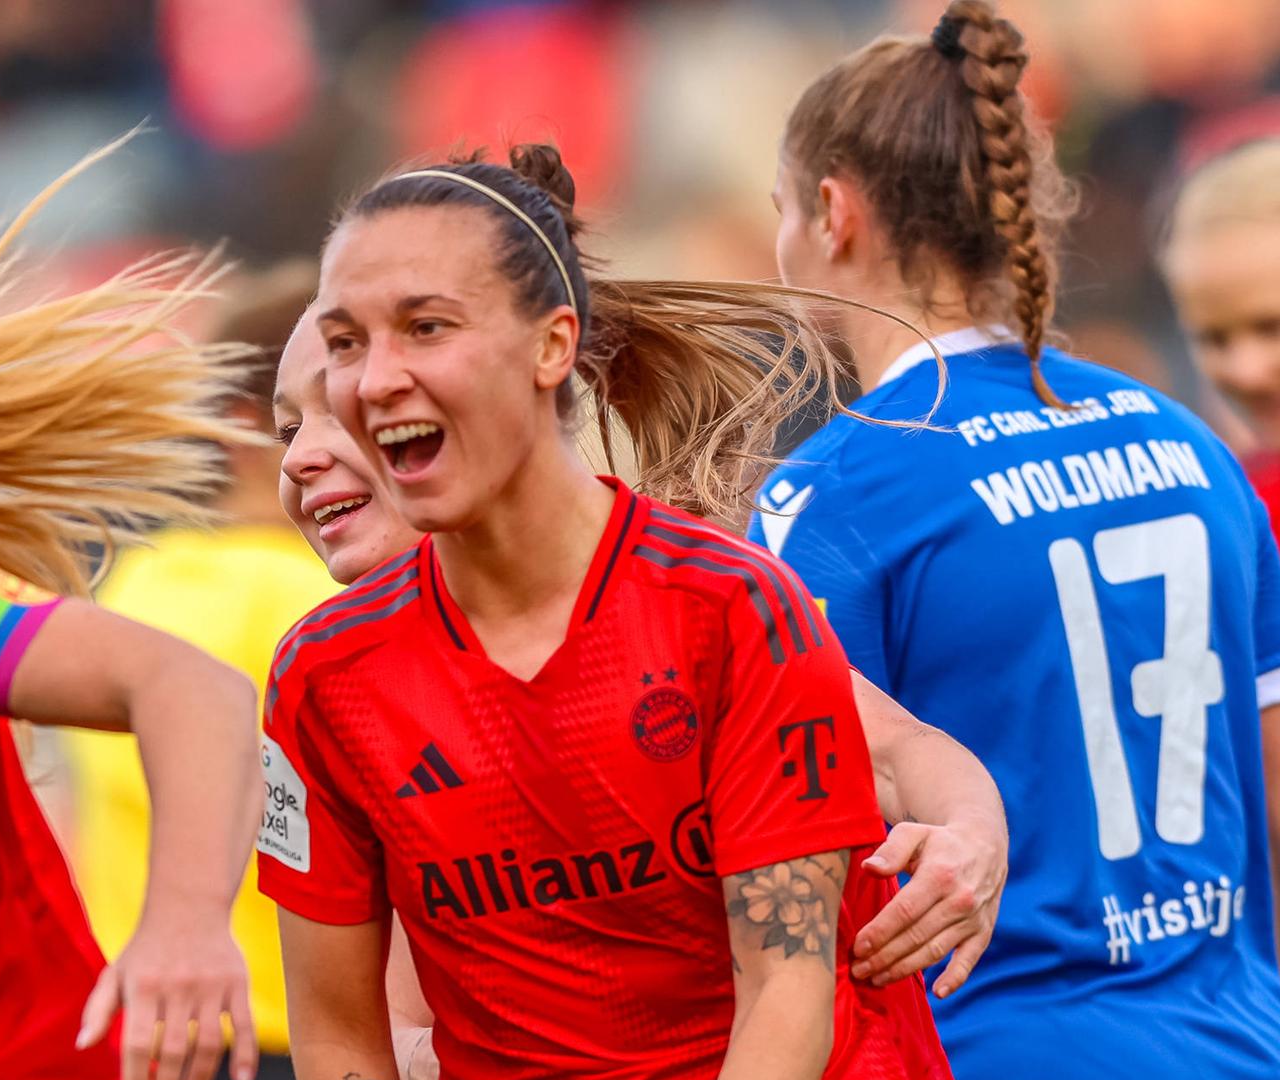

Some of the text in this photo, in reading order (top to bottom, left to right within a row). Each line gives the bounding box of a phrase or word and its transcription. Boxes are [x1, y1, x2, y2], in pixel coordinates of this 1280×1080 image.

[957, 415, 998, 447] FC
[989, 410, 1051, 436] CARL
[1106, 389, 1160, 416] JENA
[970, 439, 1211, 526] WOLDMANN
[1048, 512, 1225, 861] 17
[777, 715, 838, 802] T
[416, 840, 667, 919] Allianz
